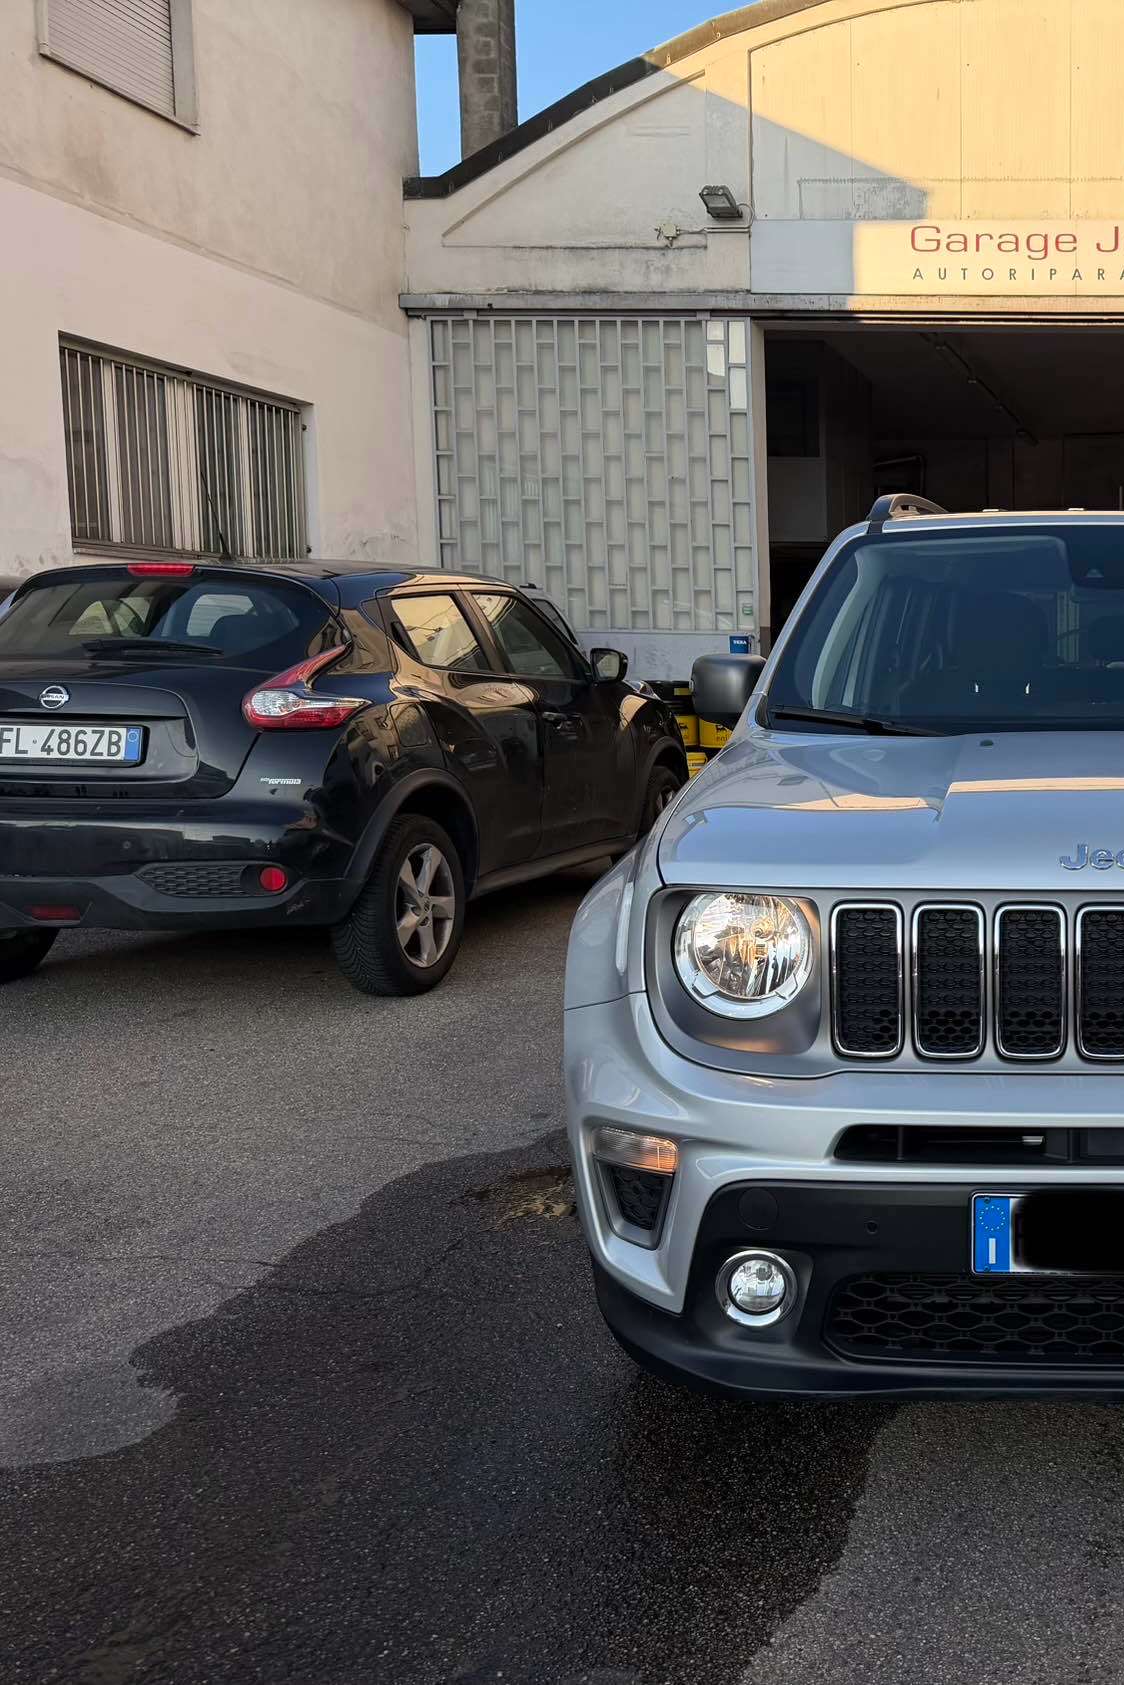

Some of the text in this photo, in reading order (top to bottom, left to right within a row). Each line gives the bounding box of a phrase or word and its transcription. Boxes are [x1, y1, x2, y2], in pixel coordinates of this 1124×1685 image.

[911, 225, 1077, 261] Garage
[0, 727, 122, 757] FL 486ZB
